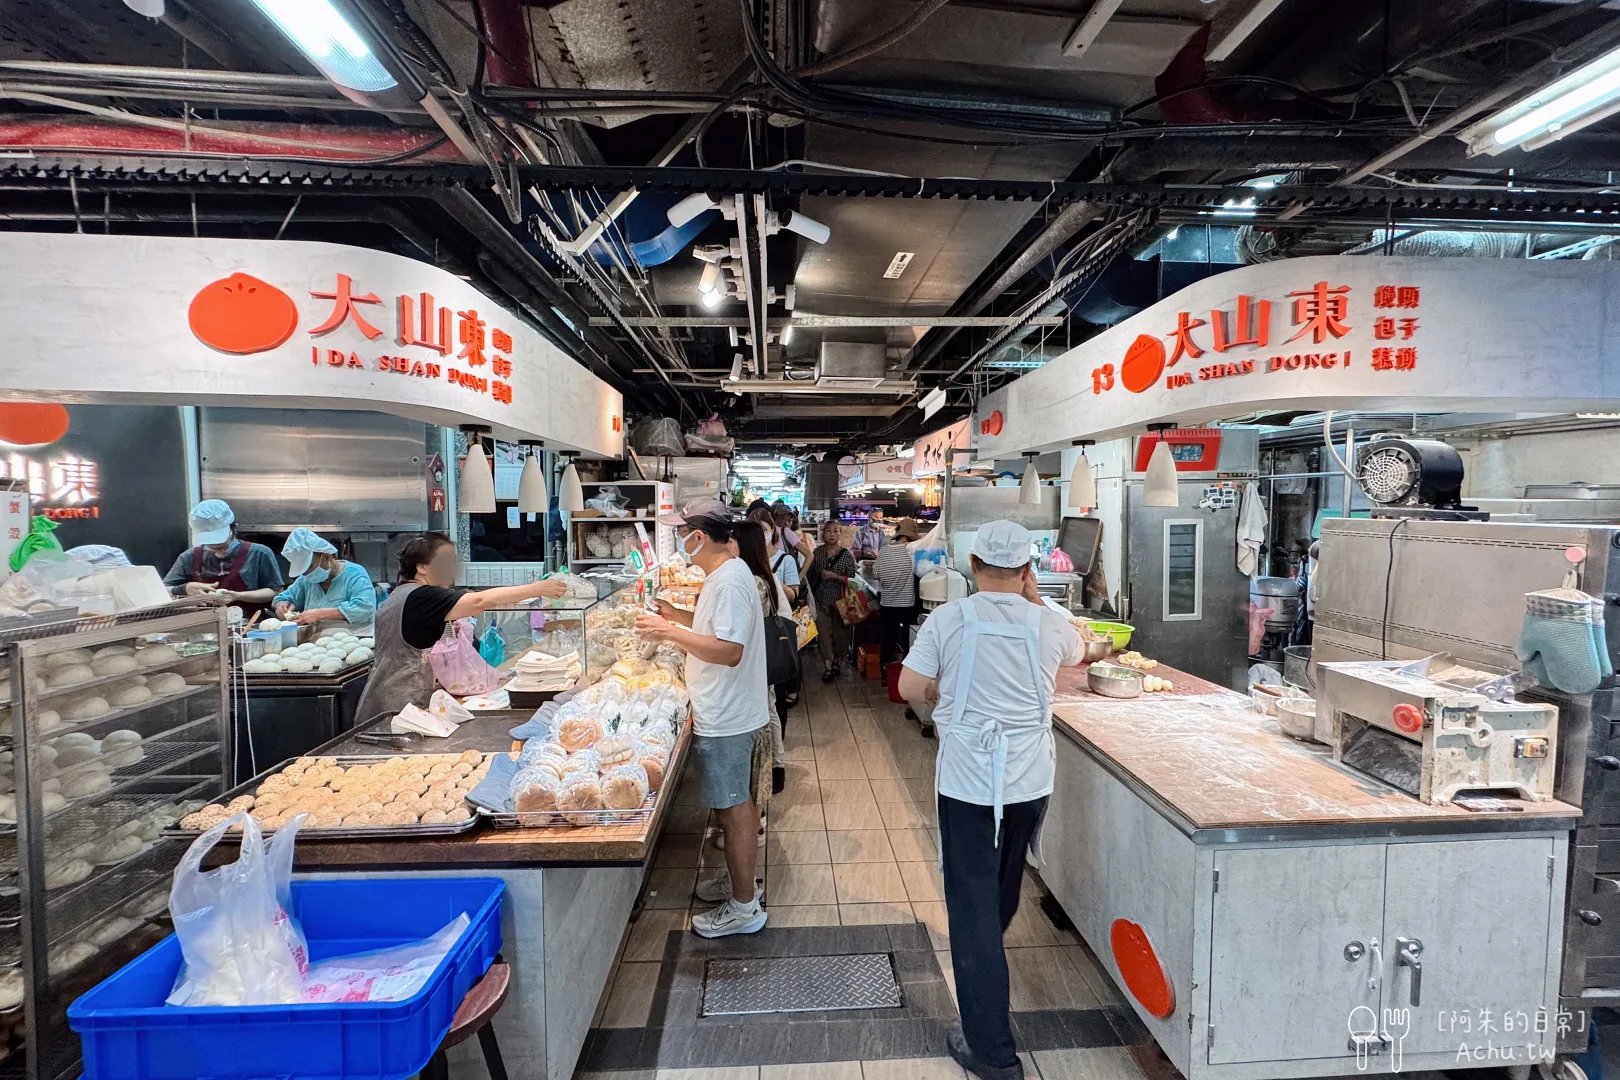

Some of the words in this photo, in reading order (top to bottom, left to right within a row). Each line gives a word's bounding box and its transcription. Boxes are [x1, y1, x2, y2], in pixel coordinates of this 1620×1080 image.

[308, 272, 486, 367] 大山東
[1165, 280, 1352, 367] 大山東
[1373, 315, 1421, 340] 包子
[326, 349, 363, 369] DA
[378, 355, 441, 379] SHAN
[1091, 363, 1115, 395] 13
[1198, 358, 1256, 381] SHAN
[1270, 350, 1340, 373] DONG
